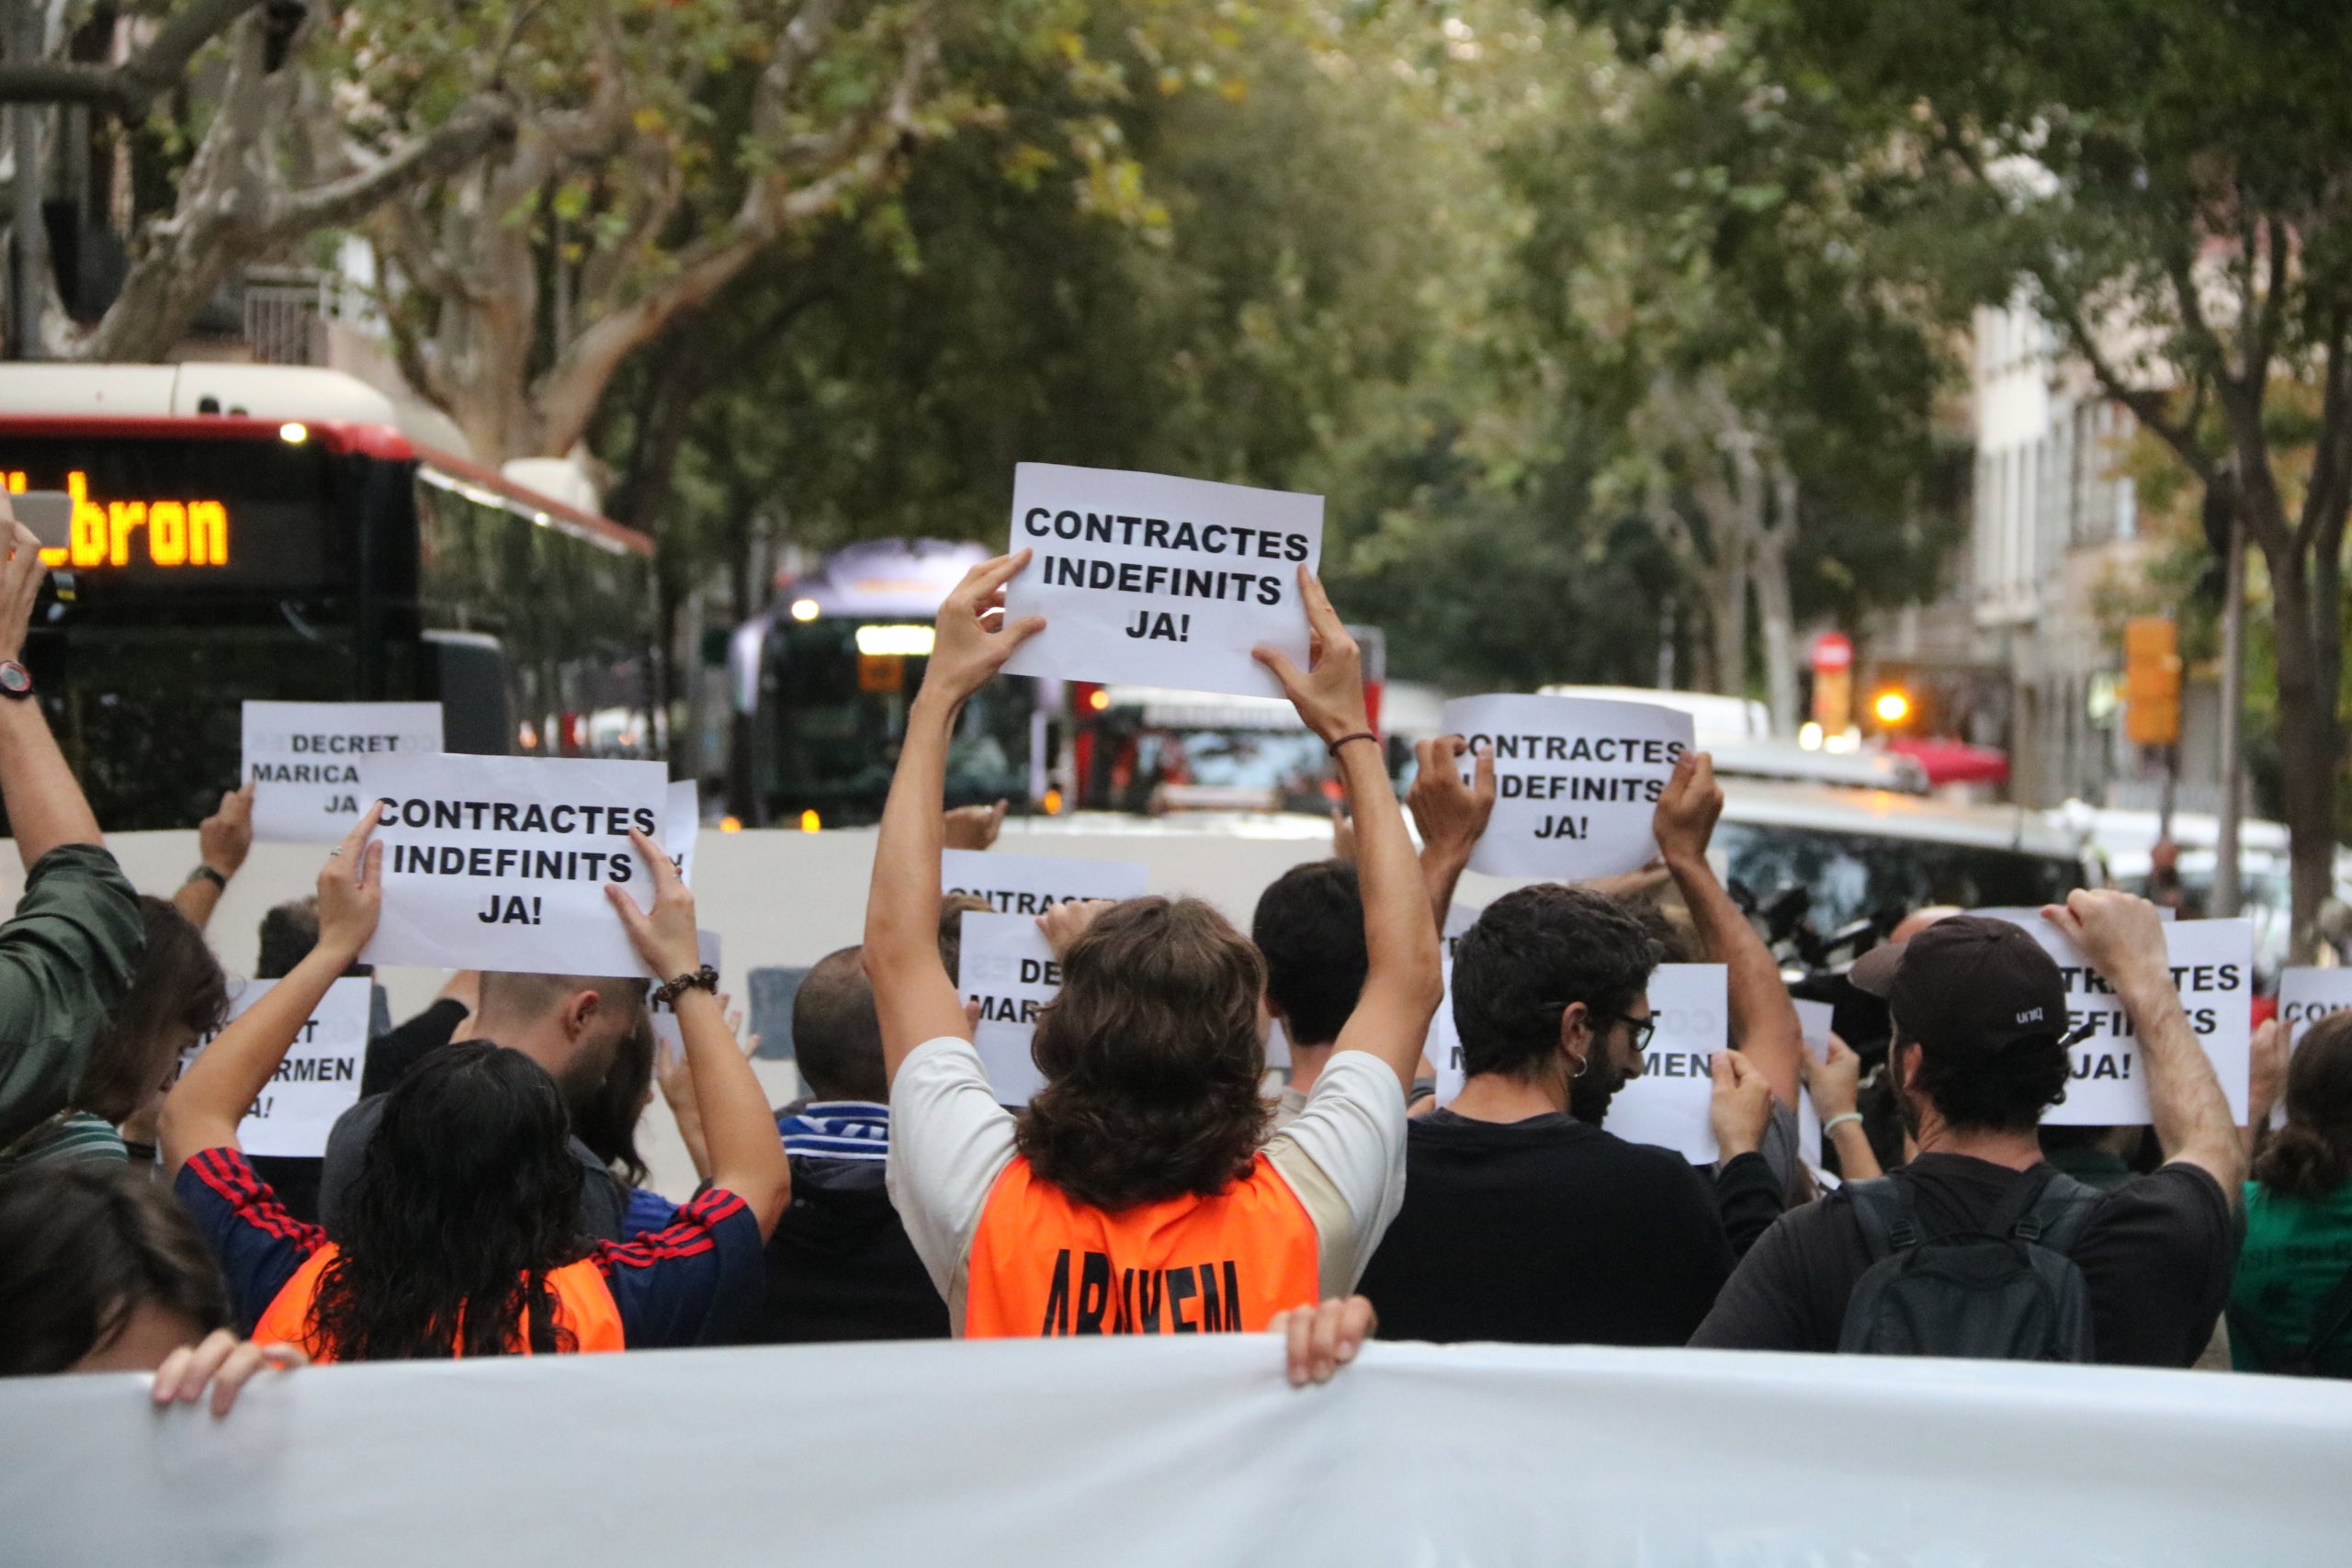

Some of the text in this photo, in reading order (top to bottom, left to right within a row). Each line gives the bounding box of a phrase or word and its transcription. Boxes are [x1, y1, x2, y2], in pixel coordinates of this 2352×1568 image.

[0, 470, 229, 567] bron
[1024, 507, 1309, 562] CONTRACTES
[1043, 555, 1283, 606] INDEFINITS
[1125, 610, 1191, 643] JA!
[291, 734, 400, 754] DECRET
[251, 763, 360, 784] MARICA
[1463, 773, 1665, 803] DEFINITS
[324, 795, 359, 813] JA
[377, 797, 655, 838] CONTRACTES
[1533, 815, 1589, 840] JA!
[393, 844, 632, 883] INDEFINITS
[478, 895, 542, 925] JA!
[2071, 1054, 2132, 1080] JA!
[245, 1097, 274, 1119] A!
